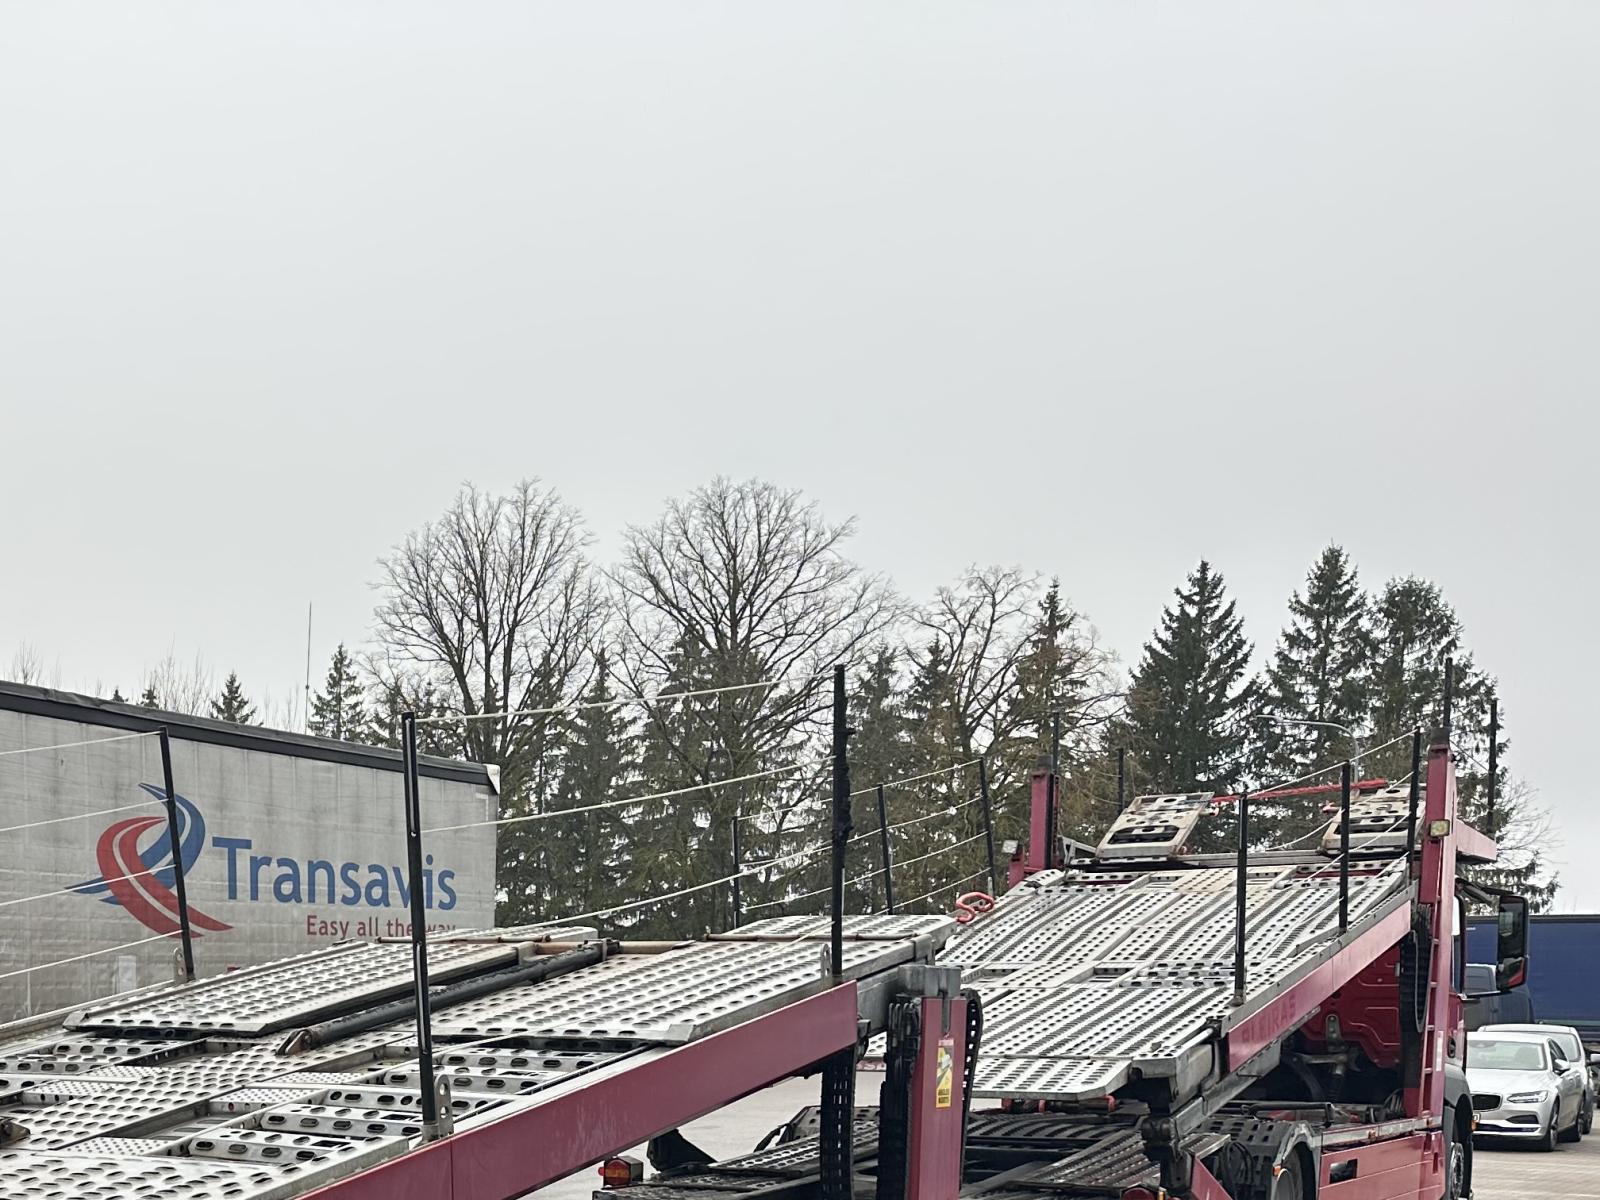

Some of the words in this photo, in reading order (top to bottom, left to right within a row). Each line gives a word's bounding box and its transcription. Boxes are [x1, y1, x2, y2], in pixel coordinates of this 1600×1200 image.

[212, 836, 457, 911] Transavis
[306, 915, 349, 939] Easy
[357, 917, 379, 937] all
[387, 918, 412, 937] the
